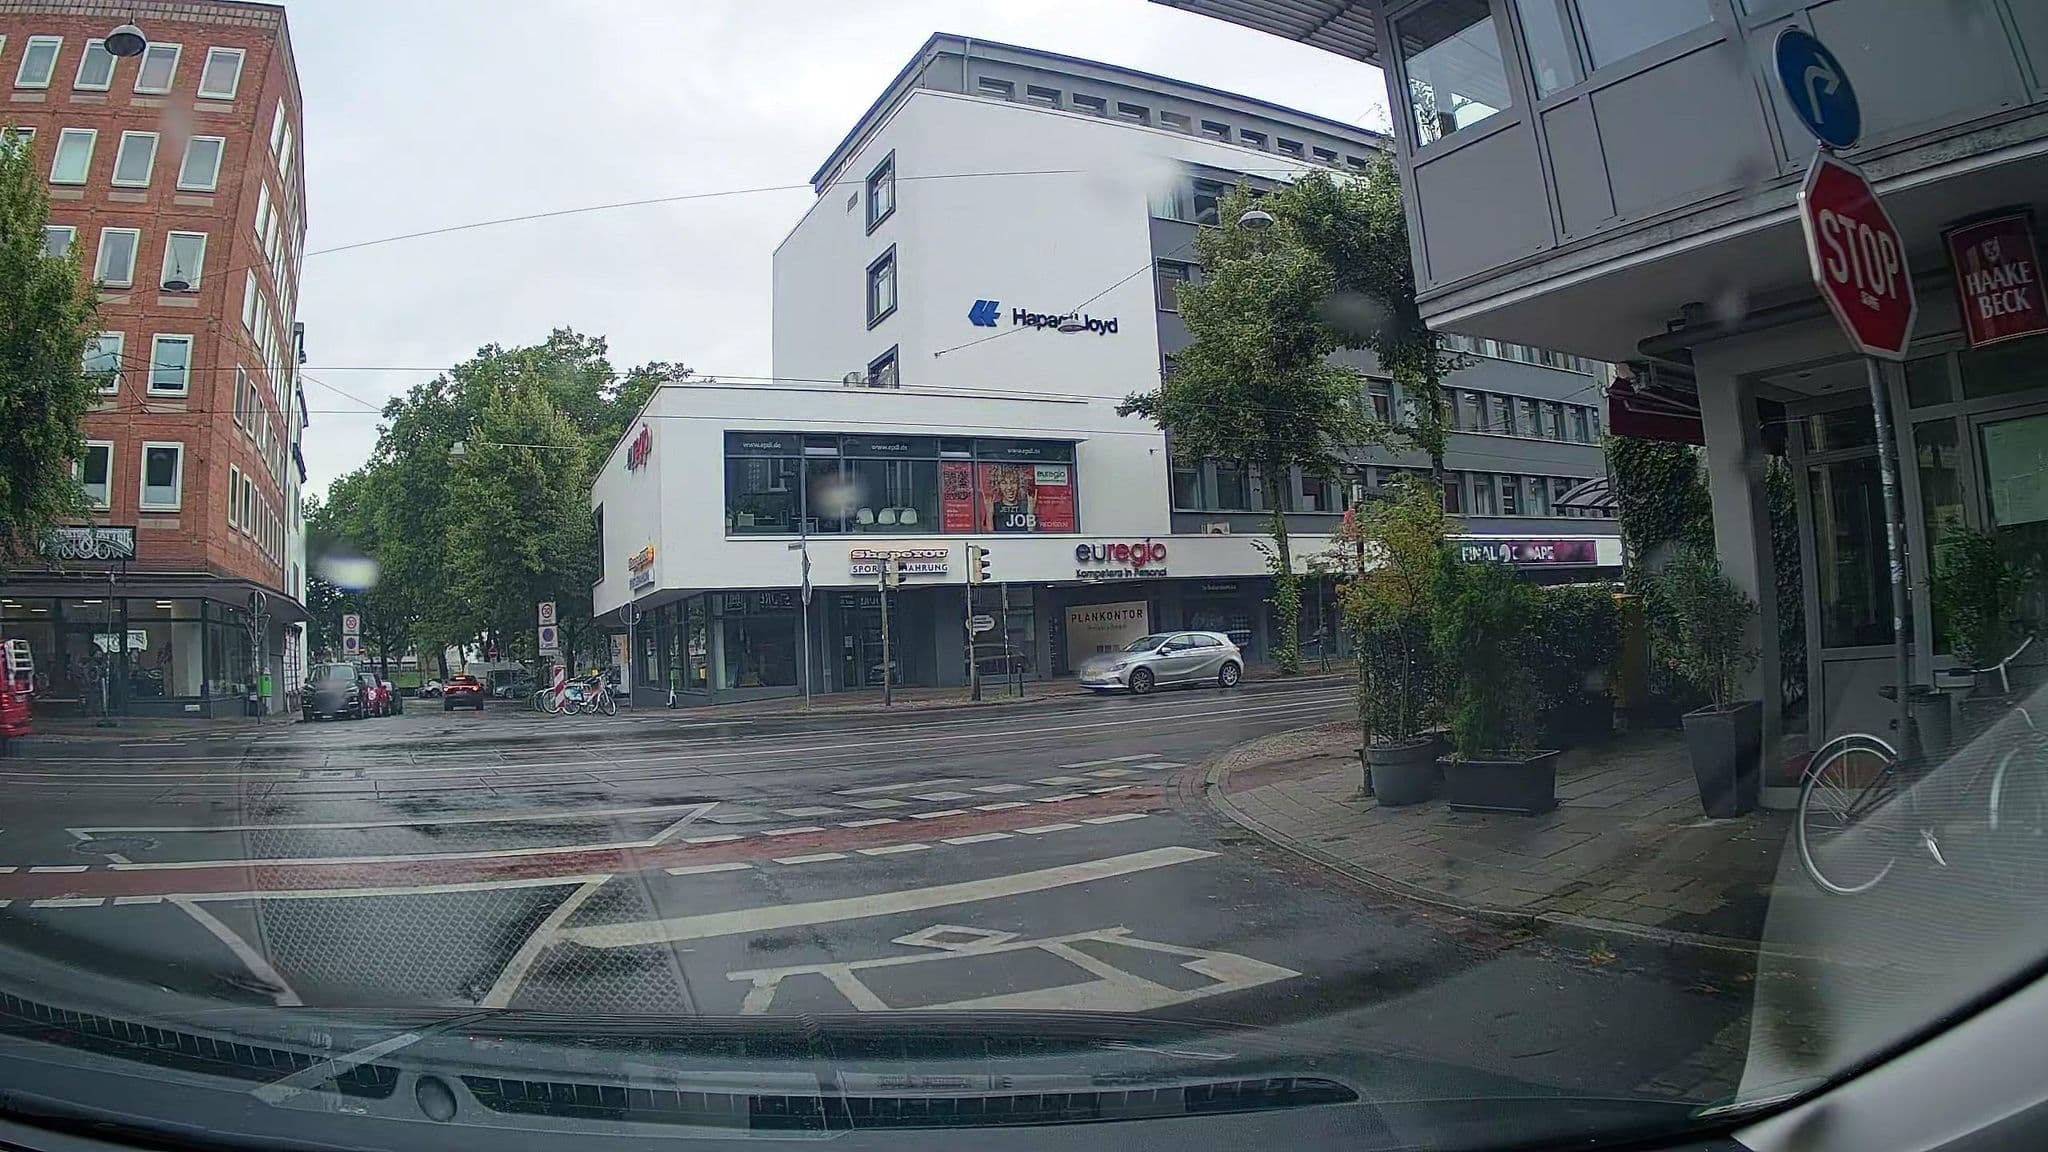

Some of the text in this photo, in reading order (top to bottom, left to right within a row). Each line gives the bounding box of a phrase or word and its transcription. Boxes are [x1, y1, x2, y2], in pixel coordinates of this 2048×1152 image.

[1820, 208, 1899, 299] STOP
[1966, 261, 2033, 296] HAAKE
[1978, 287, 2032, 319] BECK
[1005, 514, 1037, 528] JOB
[1076, 537, 1168, 568] euregio
[1461, 546, 1498, 561] FINAL
[1071, 609, 1144, 623] PLANKONTOR
